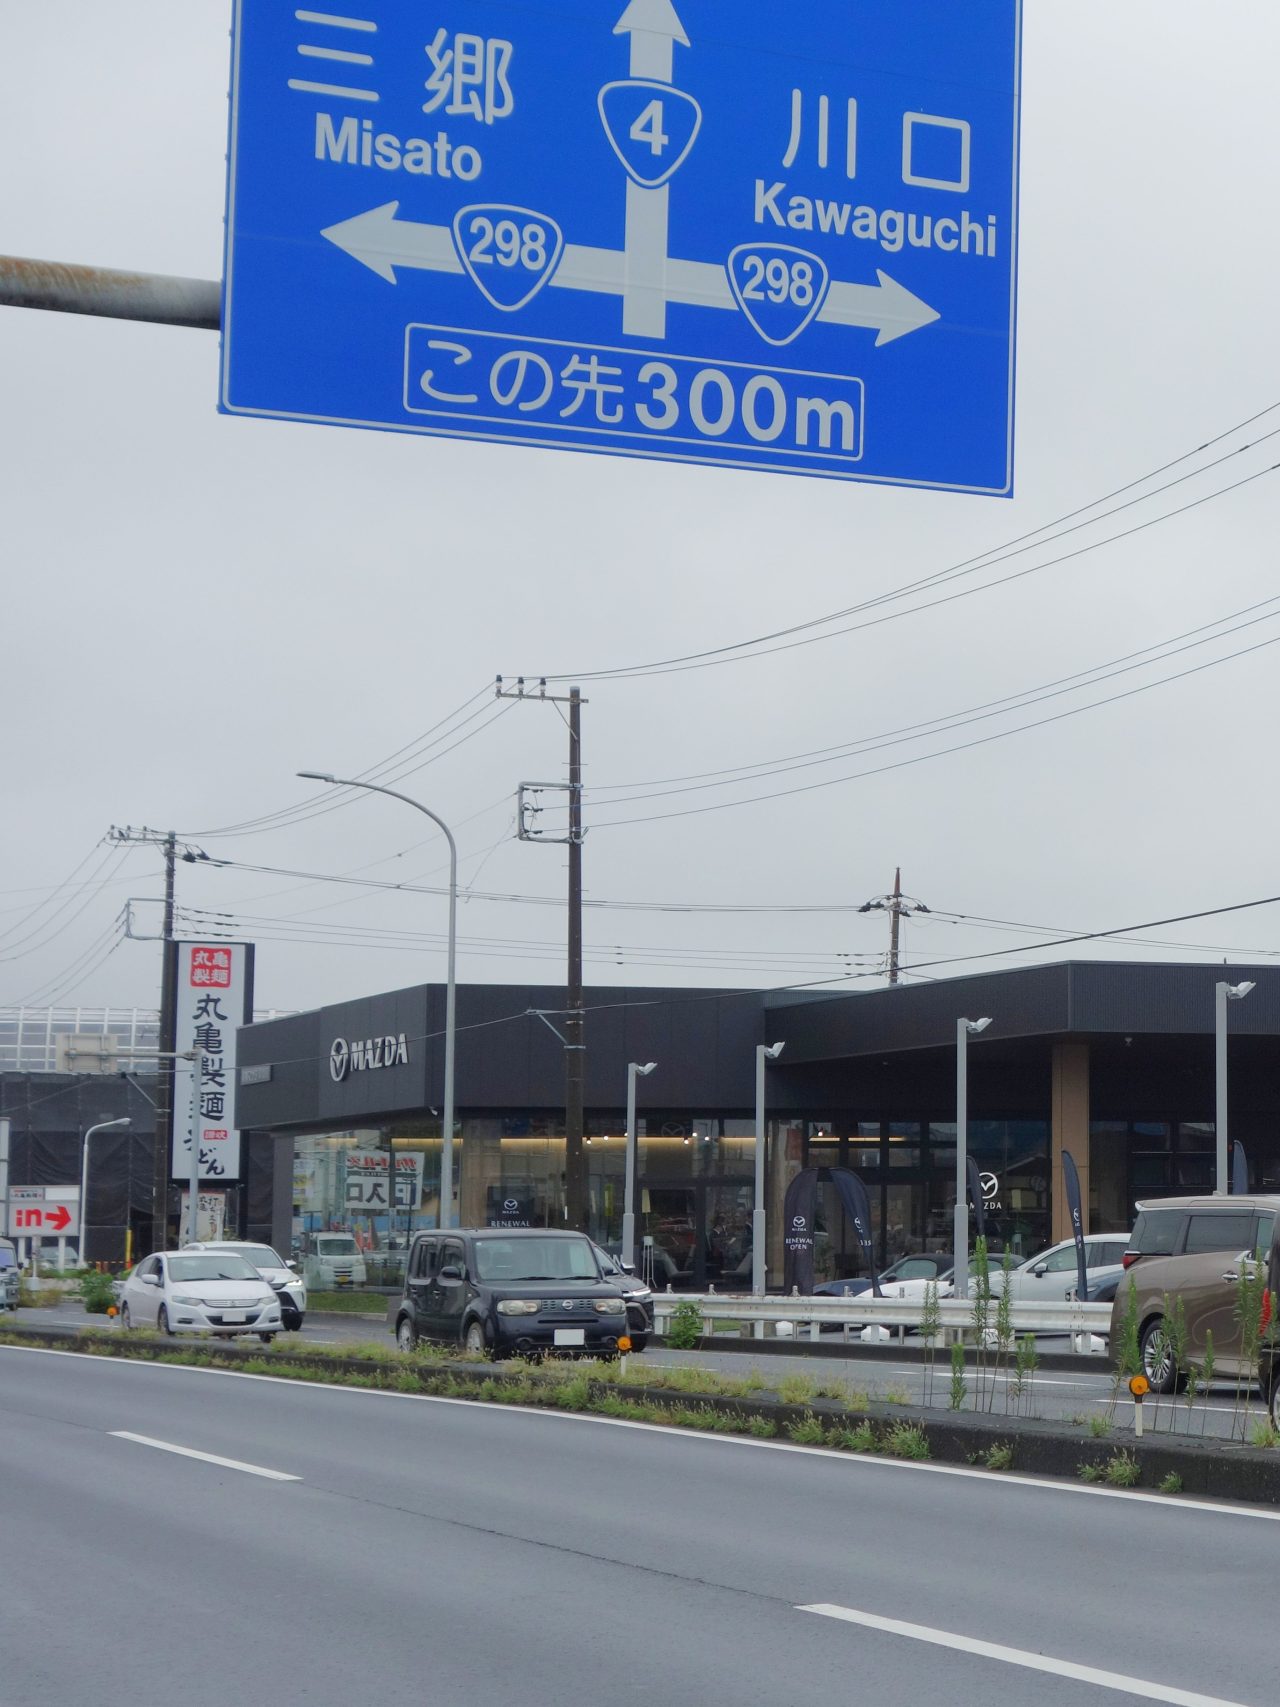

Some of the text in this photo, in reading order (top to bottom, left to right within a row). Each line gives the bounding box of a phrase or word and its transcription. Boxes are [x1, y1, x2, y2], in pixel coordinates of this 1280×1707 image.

[287, 9, 514, 124] 三郷
[314, 113, 482, 181] Misato
[629, 99, 669, 156] 4
[782, 88, 971, 193] 川口
[754, 179, 997, 257] Kawaguchi
[468, 221, 546, 271] 298
[741, 256, 815, 304] 298
[420, 340, 855, 450] この先300m
[350, 1033, 408, 1072] MAZDA
[16, 1209, 42, 1227] in
[968, 1202, 1002, 1210] MZDA
[785, 1237, 813, 1245] RENEWAL
